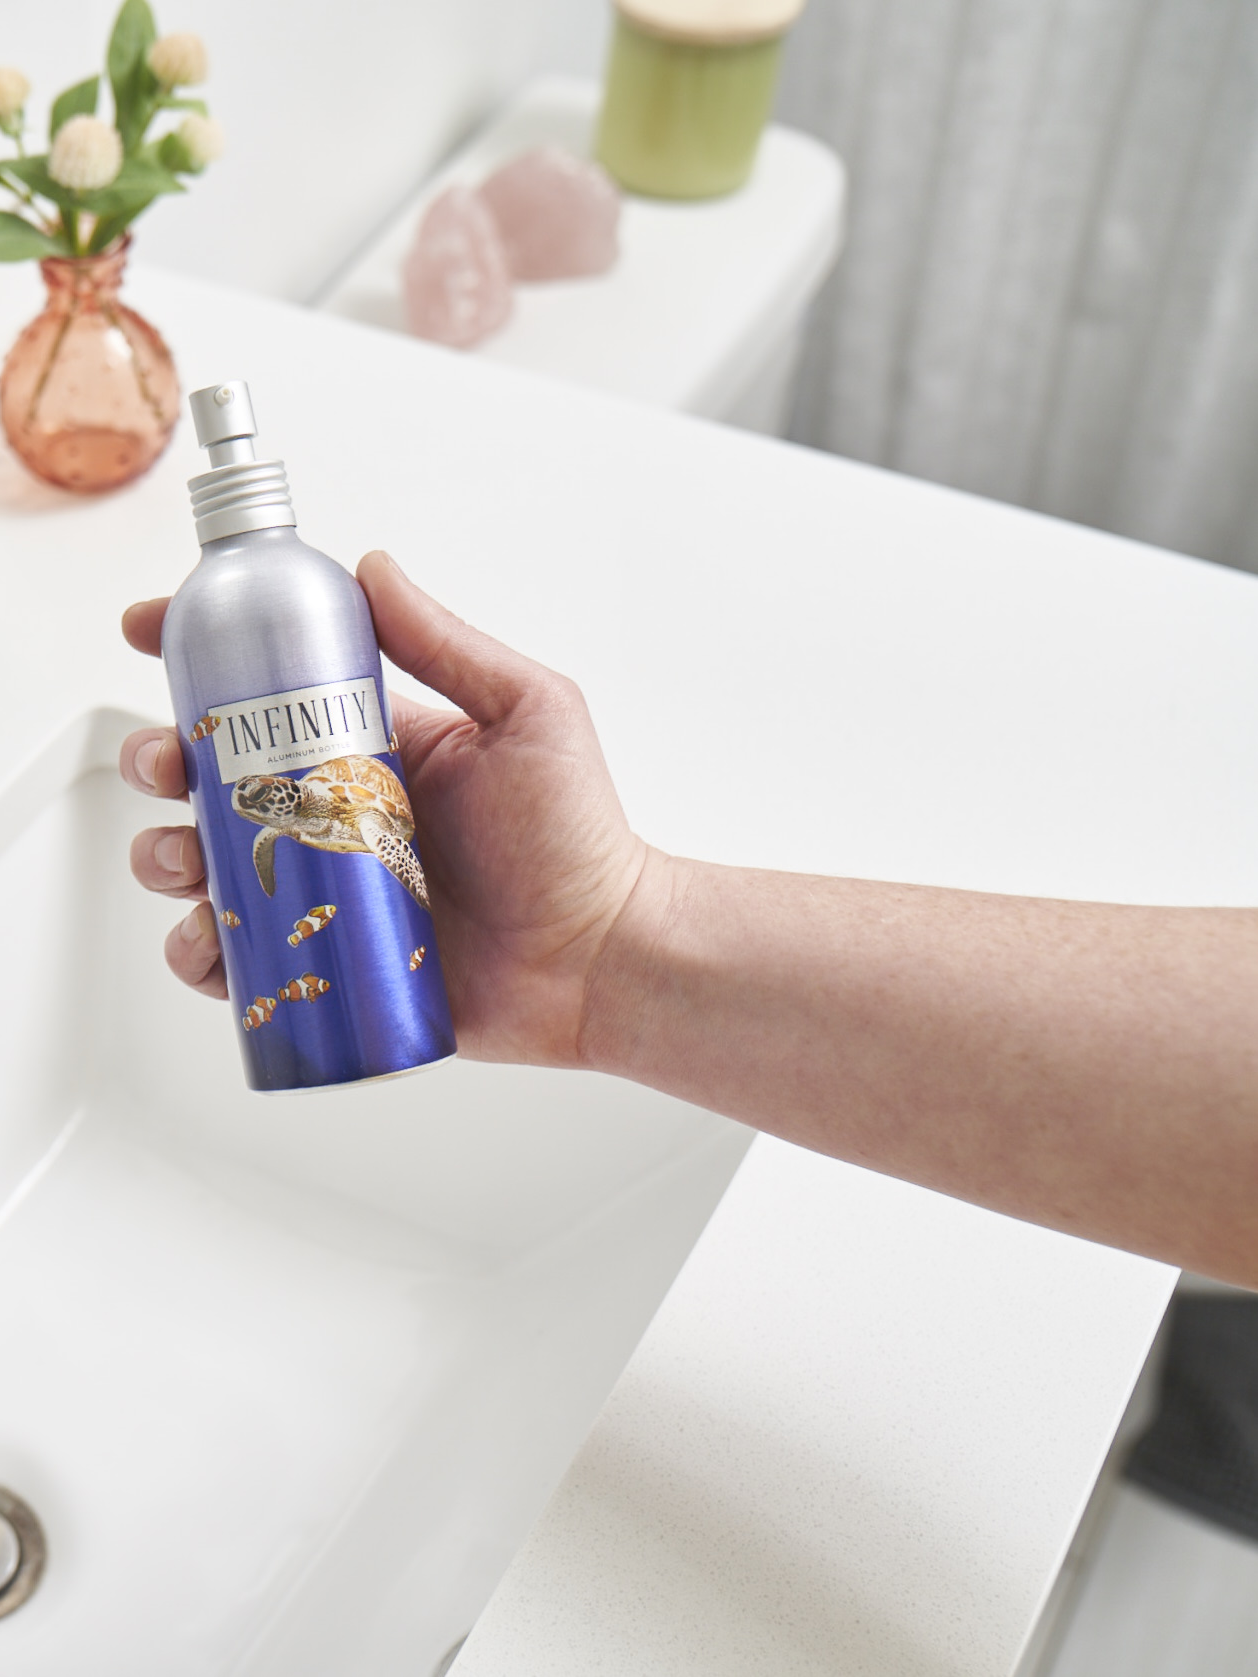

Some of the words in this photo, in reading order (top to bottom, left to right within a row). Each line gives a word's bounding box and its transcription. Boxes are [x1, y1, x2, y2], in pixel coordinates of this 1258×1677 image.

[227, 691, 368, 756] INFINITY
[267, 748, 316, 763] ALUMINUM
[319, 743, 351, 754] BOTTLE
